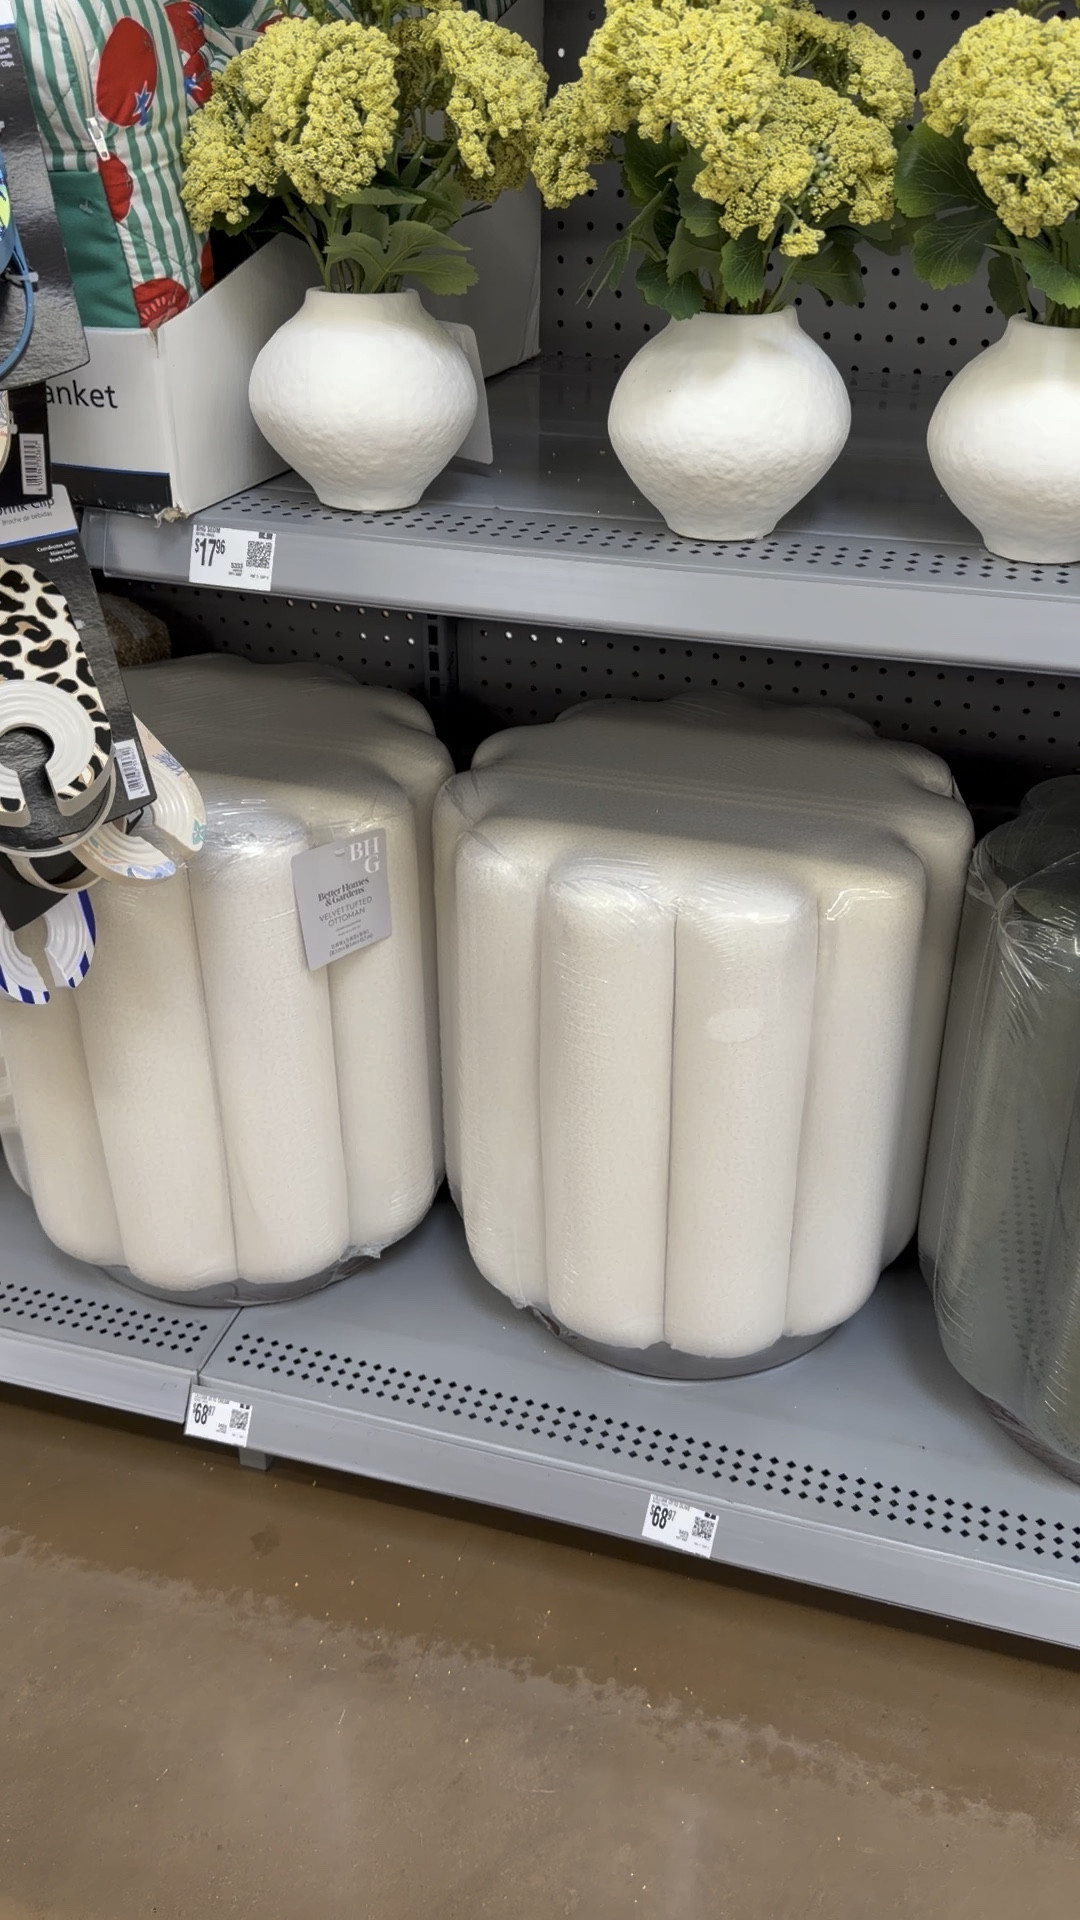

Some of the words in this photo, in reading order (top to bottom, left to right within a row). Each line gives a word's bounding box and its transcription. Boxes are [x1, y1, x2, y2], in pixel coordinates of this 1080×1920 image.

[318, 887, 341, 901] Better
[341, 877, 370, 892] Homes
[319, 904, 345, 922] VELVET
[345, 895, 373, 911] TUFTED
[328, 906, 366, 927] OTTOMAN
